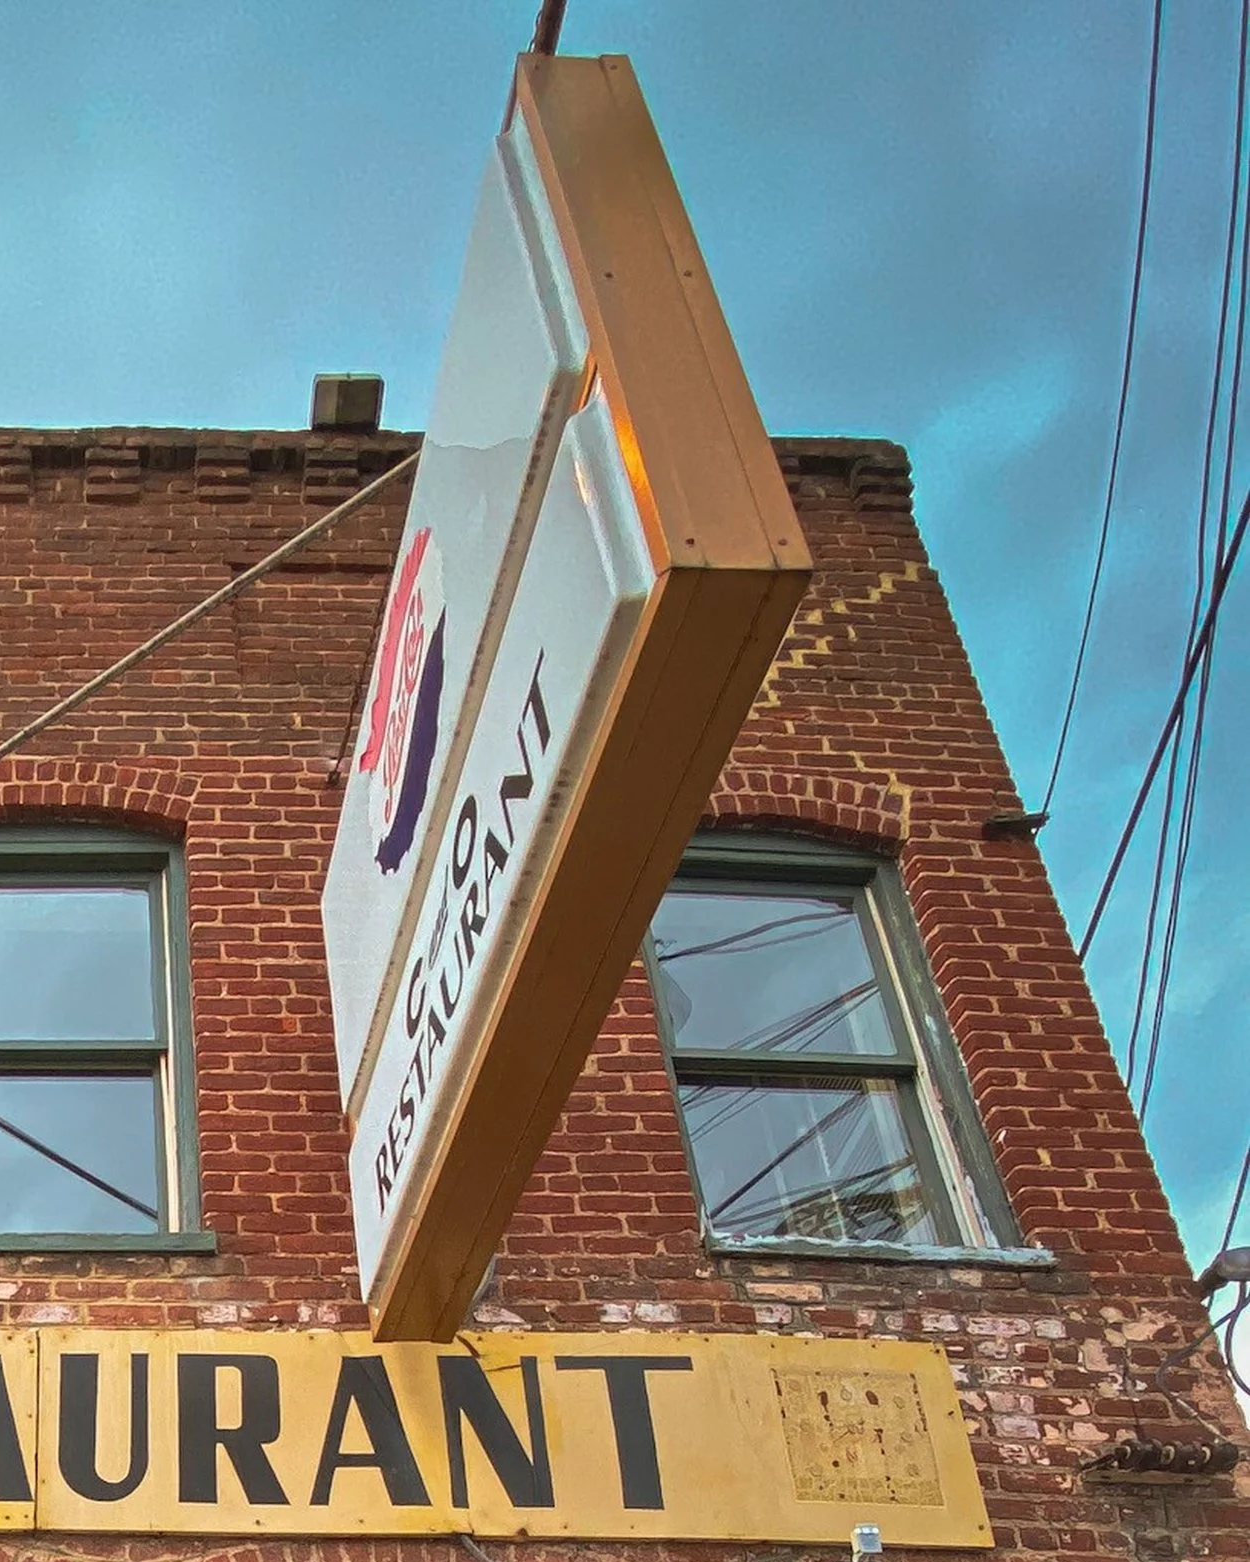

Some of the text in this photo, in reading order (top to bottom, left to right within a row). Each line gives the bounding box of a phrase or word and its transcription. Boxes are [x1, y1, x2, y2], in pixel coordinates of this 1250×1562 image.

[375, 647, 552, 1215] RESTAURANT
[406, 956, 425, 1041] C
[453, 794, 478, 890] O
